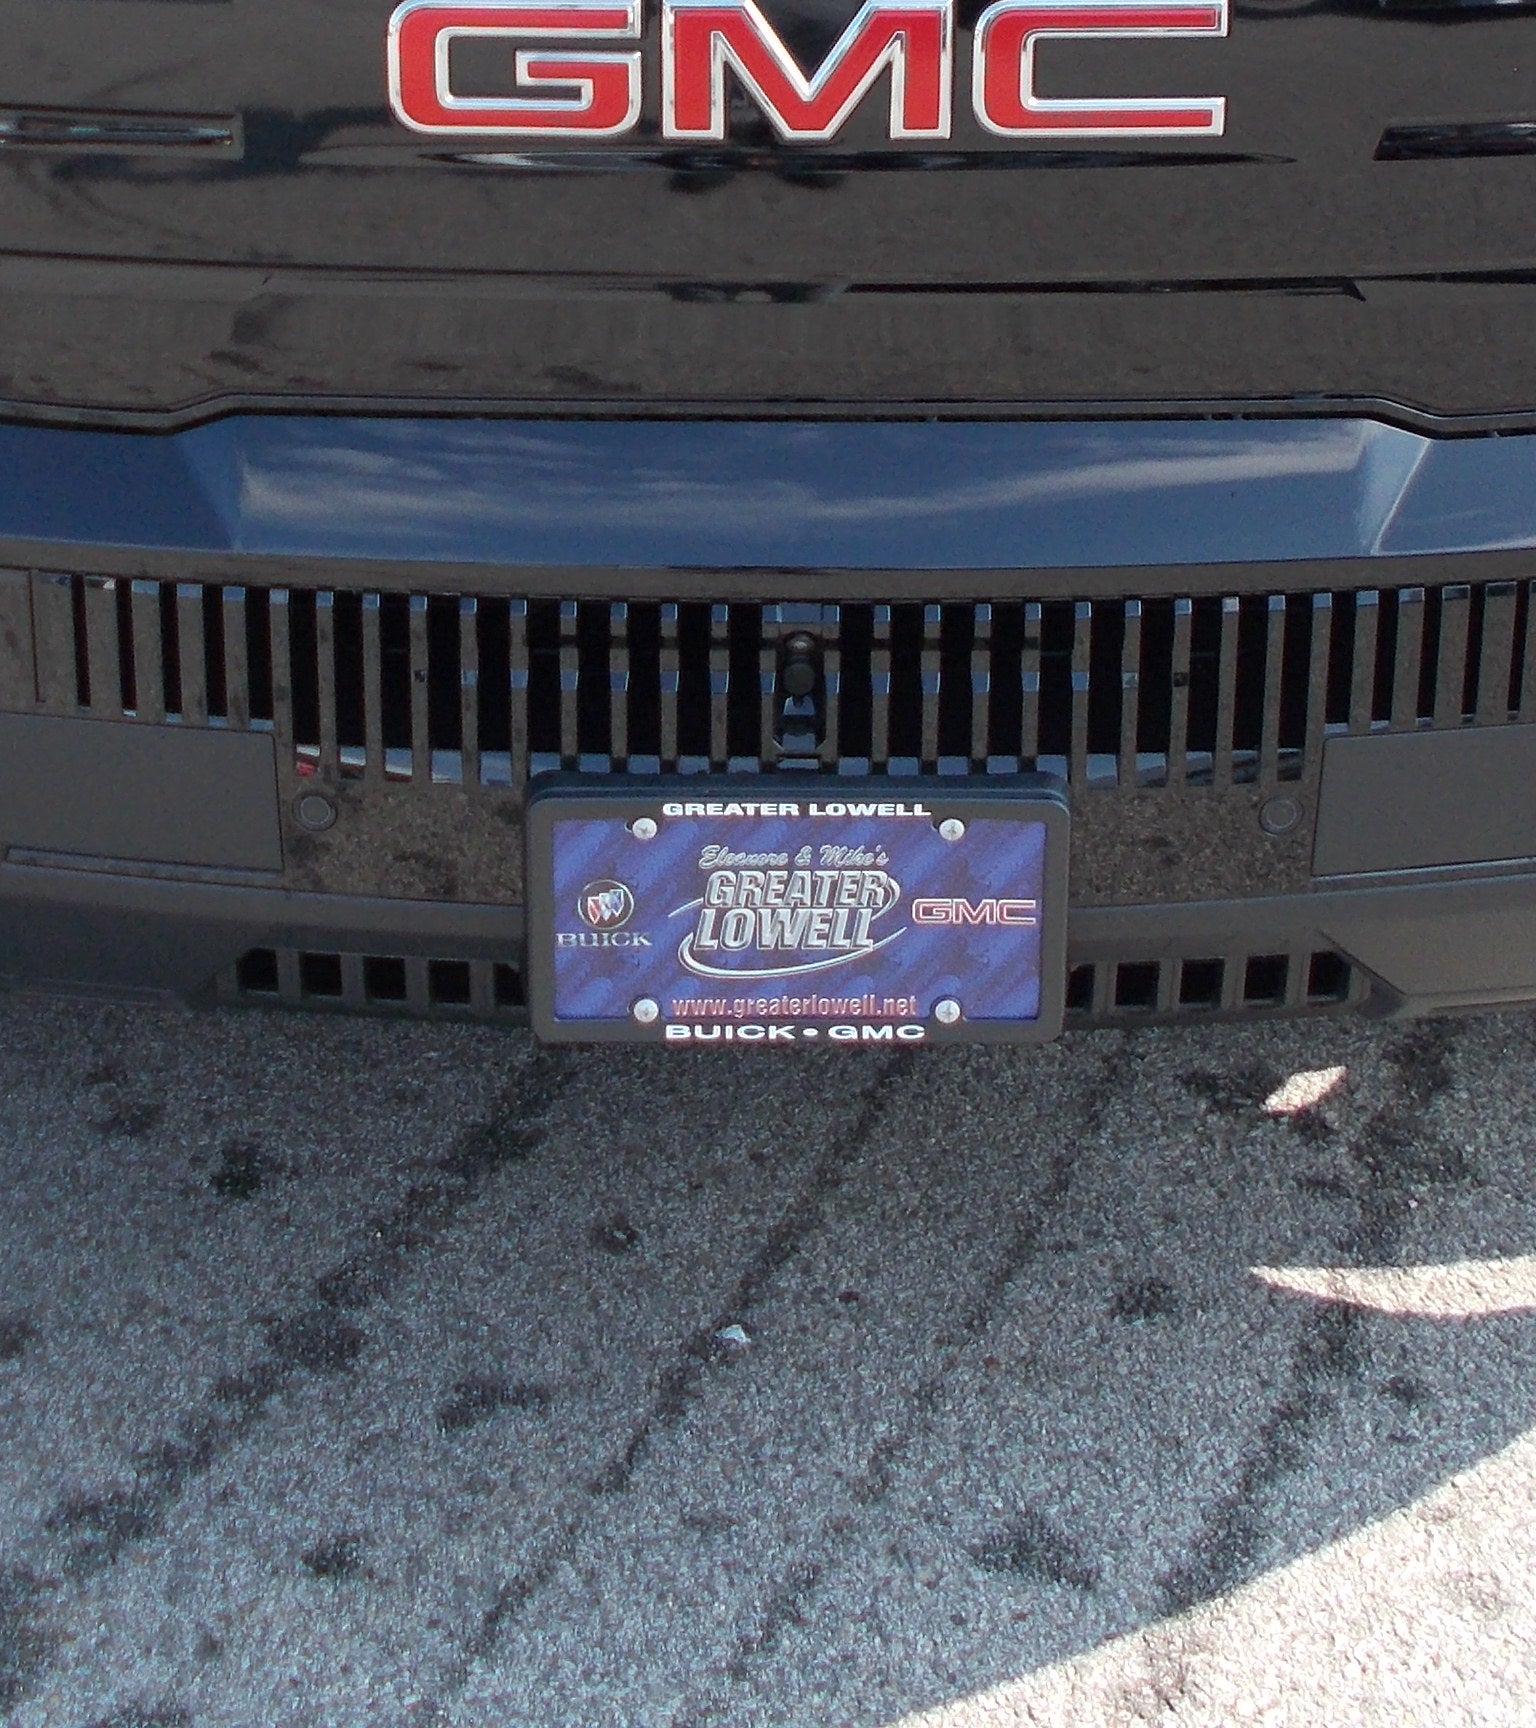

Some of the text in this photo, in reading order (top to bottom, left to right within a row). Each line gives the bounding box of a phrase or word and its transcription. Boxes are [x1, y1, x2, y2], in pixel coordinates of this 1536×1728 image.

[662, 803, 932, 816] GREATER LOWELL
[819, 844, 890, 868] Mike's
[703, 870, 889, 909] GREATER
[912, 898, 1037, 925] GMC
[555, 932, 654, 947] BUICK
[693, 907, 875, 952] LOWELL
[671, 993, 918, 1018] www.greaterlowell.net
[664, 1025, 927, 1040] BUICK GMC
